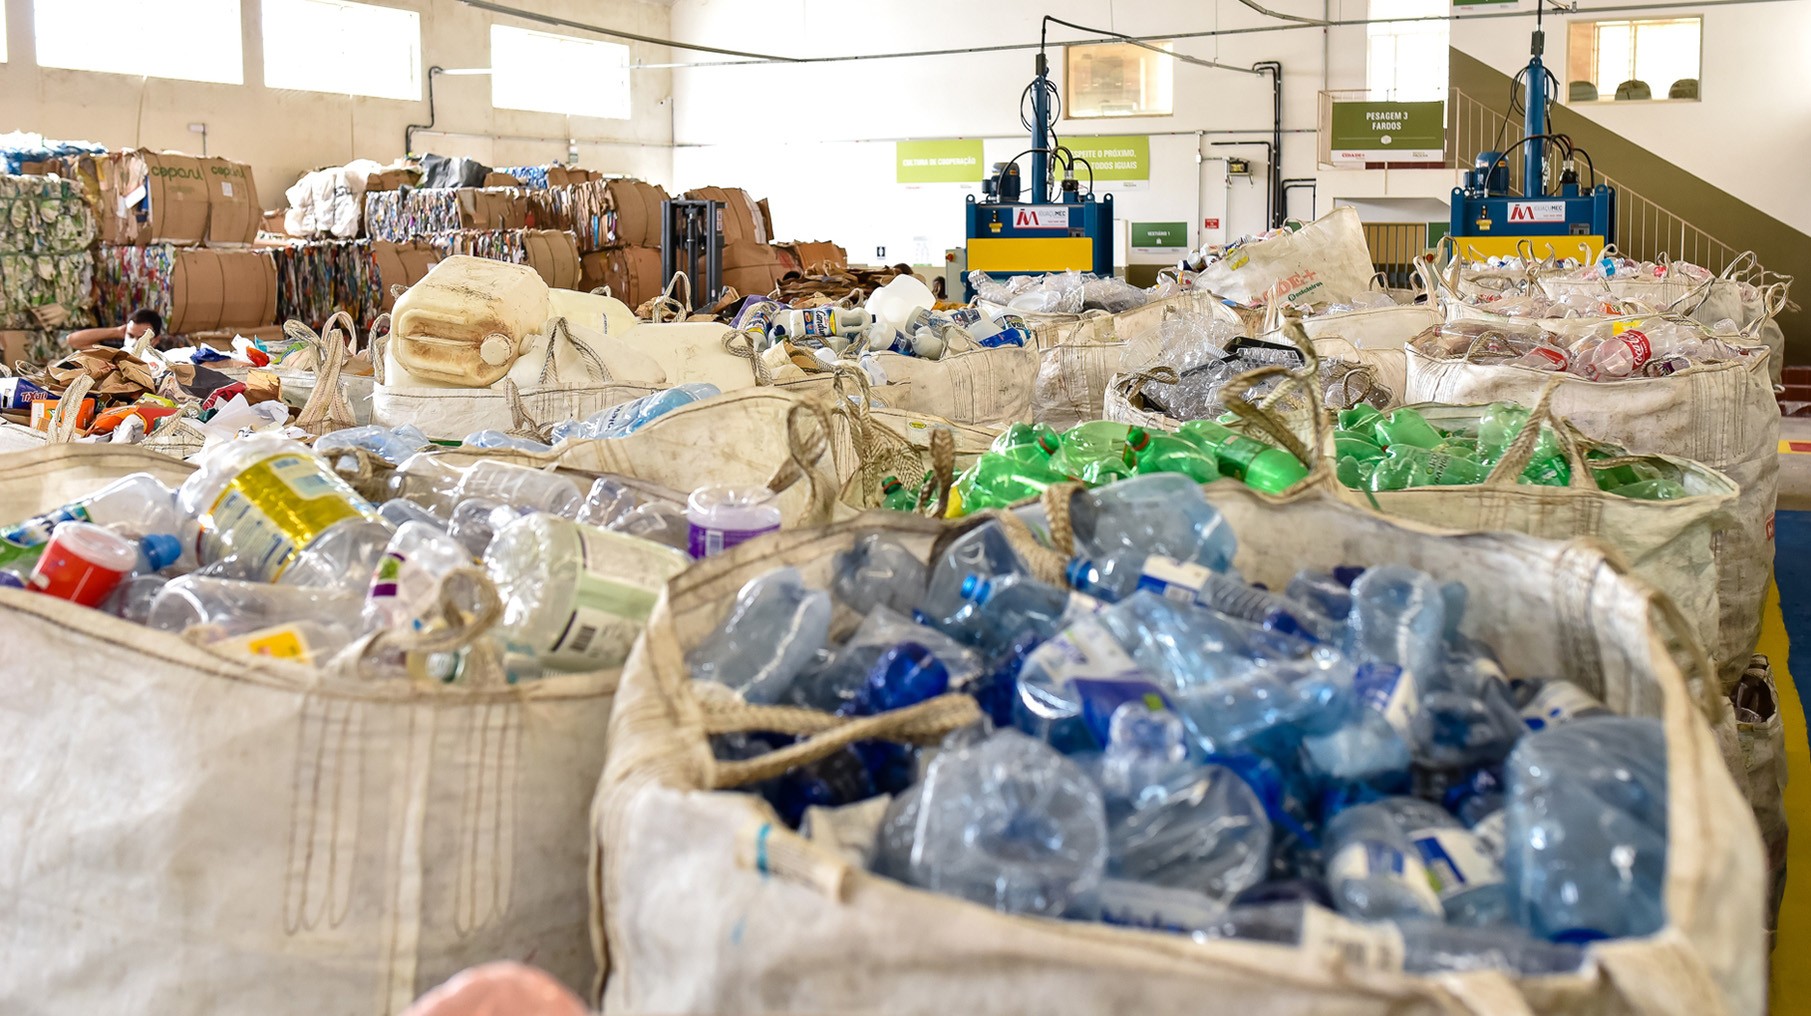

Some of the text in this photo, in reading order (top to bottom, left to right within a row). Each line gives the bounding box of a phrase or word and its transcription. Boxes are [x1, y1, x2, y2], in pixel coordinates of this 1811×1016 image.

[1366, 112, 1408, 120] PESAGEM 3
[1372, 121, 1401, 130] FARDOS
[1114, 161, 1137, 169] IGUAIS
